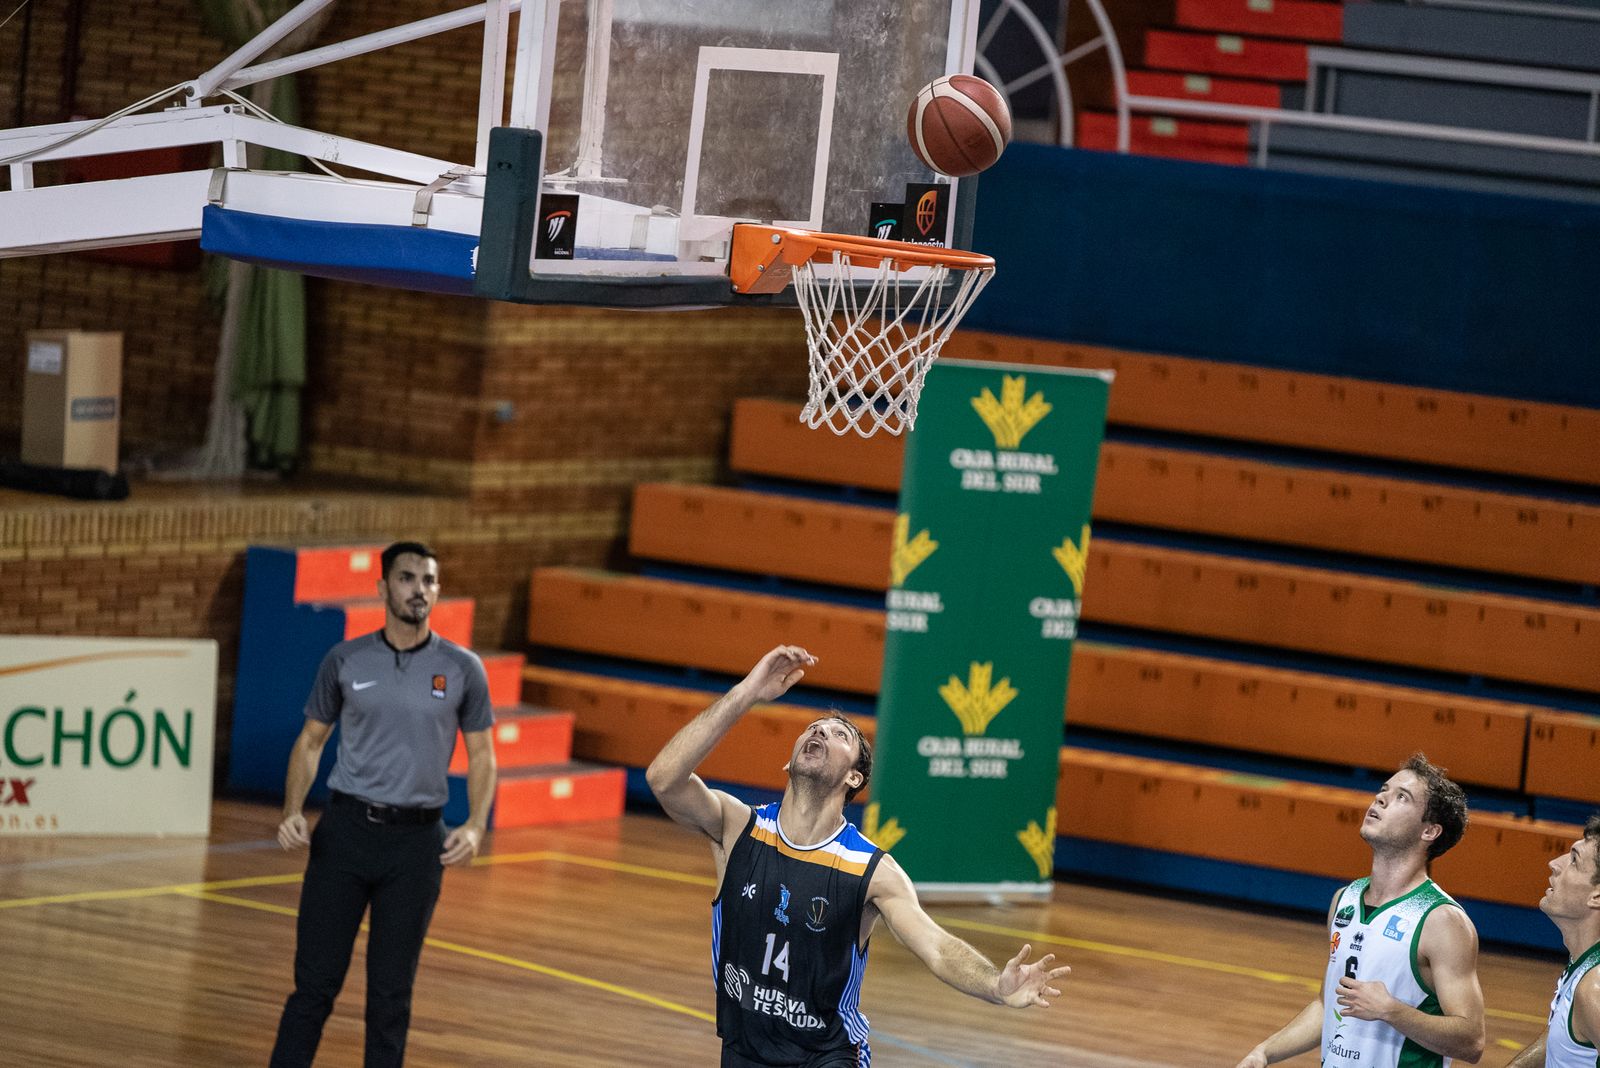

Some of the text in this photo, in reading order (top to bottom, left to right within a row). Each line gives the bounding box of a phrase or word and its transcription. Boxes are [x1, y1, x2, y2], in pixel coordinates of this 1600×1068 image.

[950, 448, 1058, 475] CAJA RURAL
[962, 470, 1041, 493] DEL SUR
[887, 611, 928, 632] SUR
[0, 690, 193, 768] CHÓN
[917, 736, 1025, 759] CAJA RURAL
[928, 758, 1008, 779] DEL SUR
[0, 777, 36, 805] X
[762, 933, 790, 983] 14
[754, 999, 827, 1029] TE SALUDA
